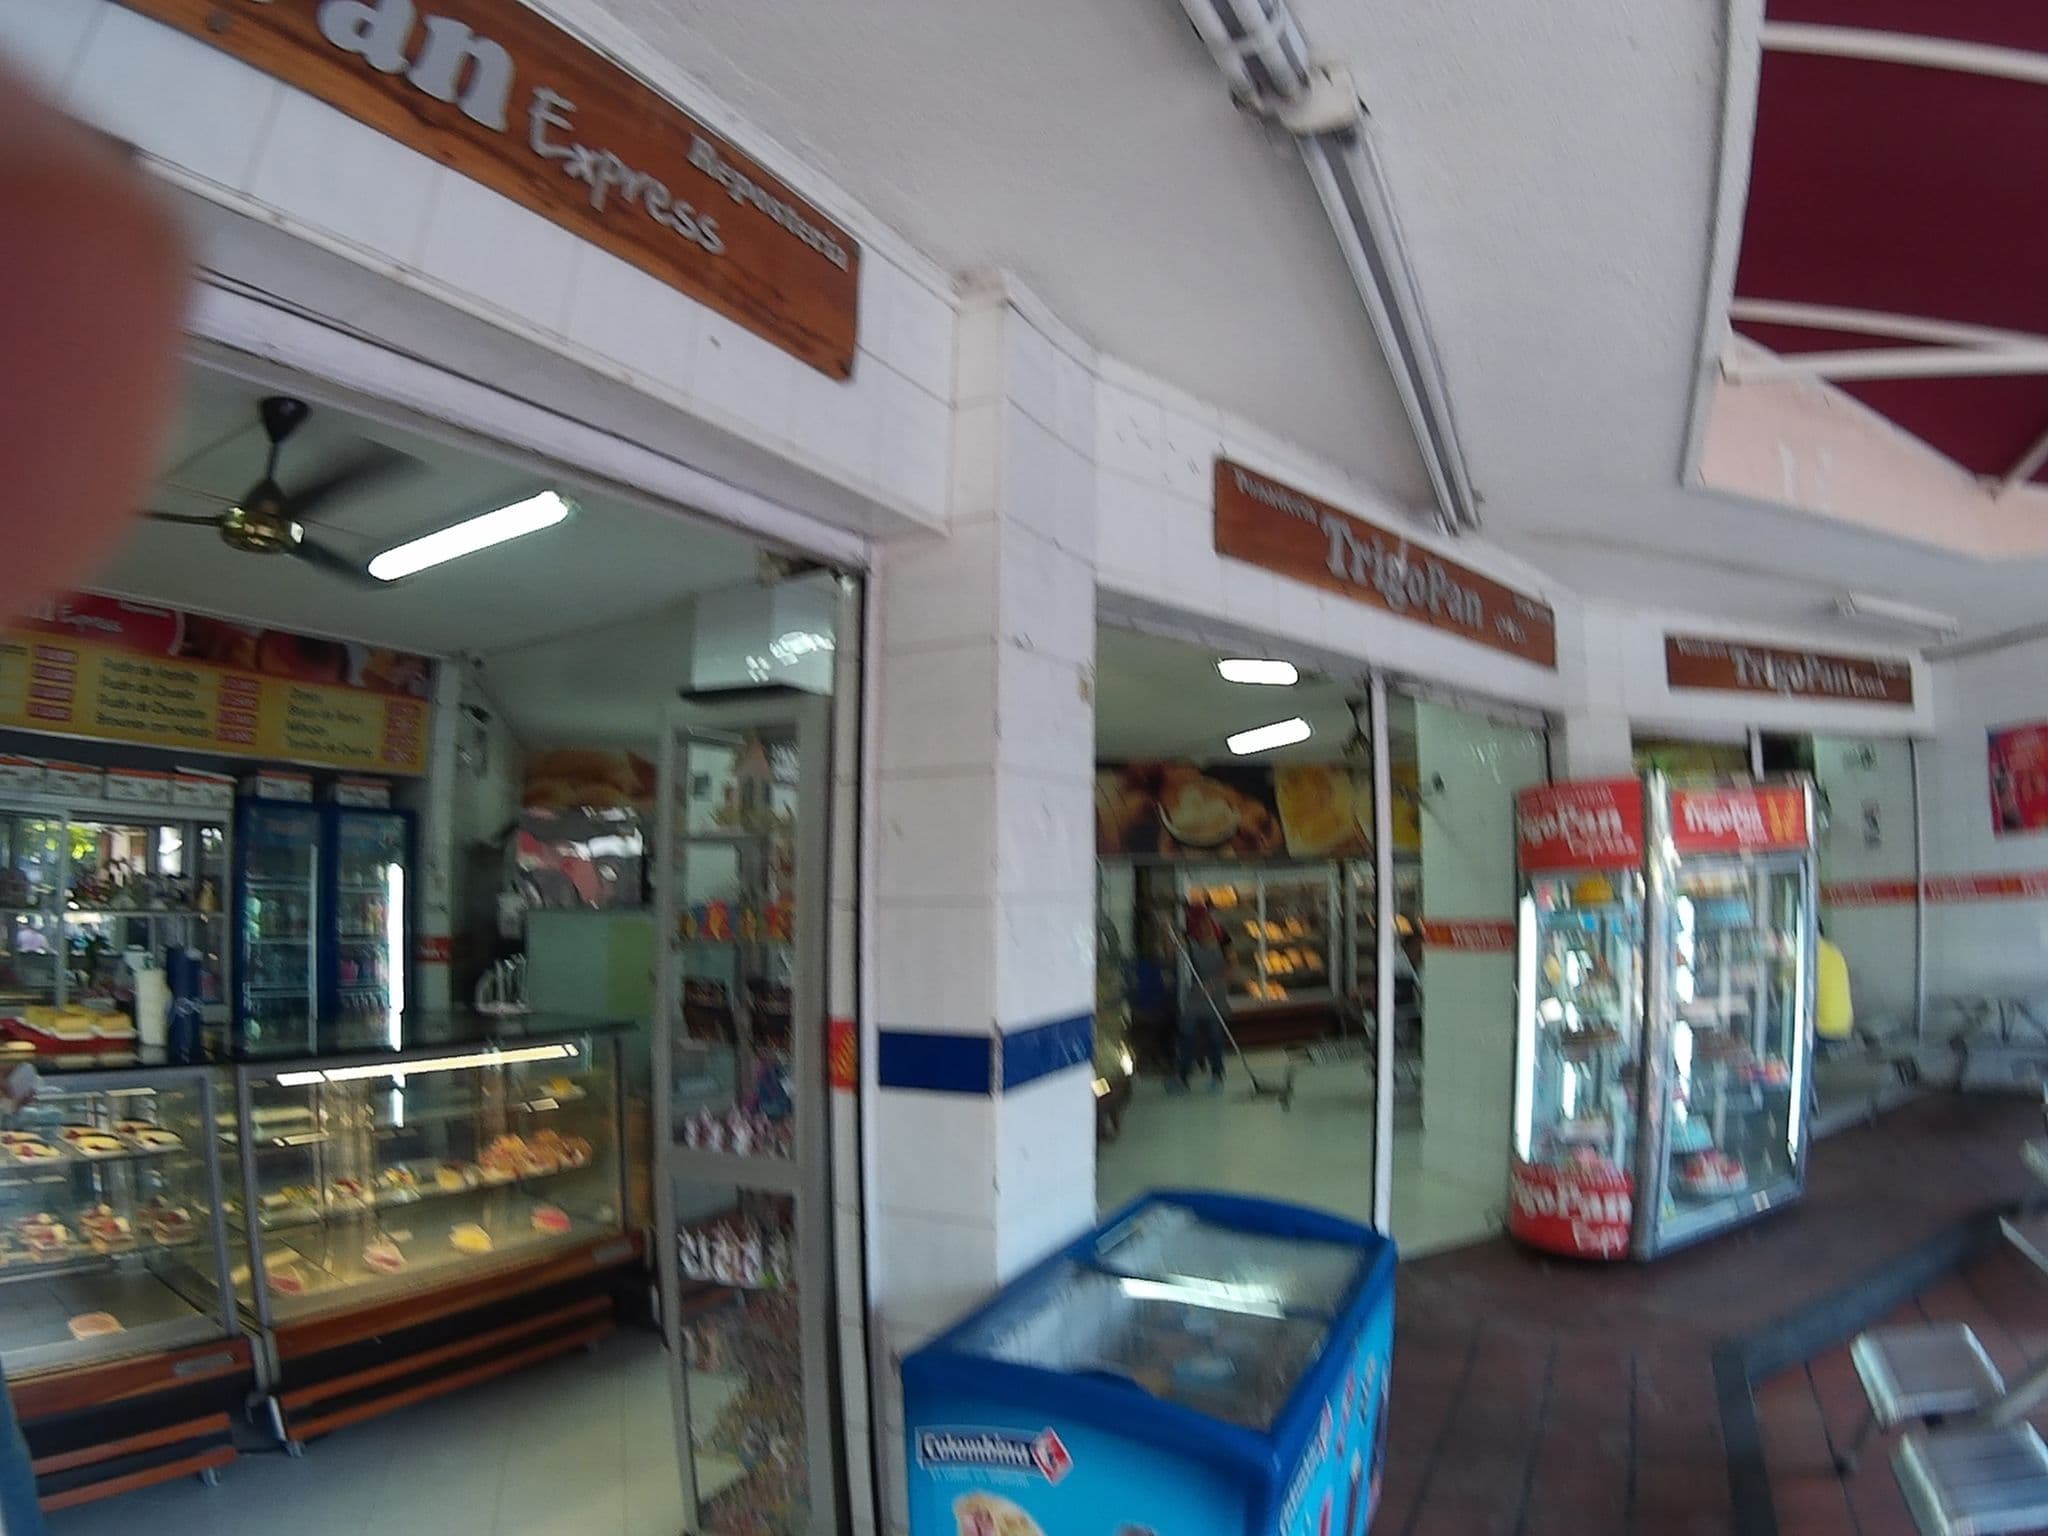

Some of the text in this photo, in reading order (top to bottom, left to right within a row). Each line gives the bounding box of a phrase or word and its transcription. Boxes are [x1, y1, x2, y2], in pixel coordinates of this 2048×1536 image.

[228, 0, 725, 256] an Express
[1319, 510, 1485, 630] TrigoPan
